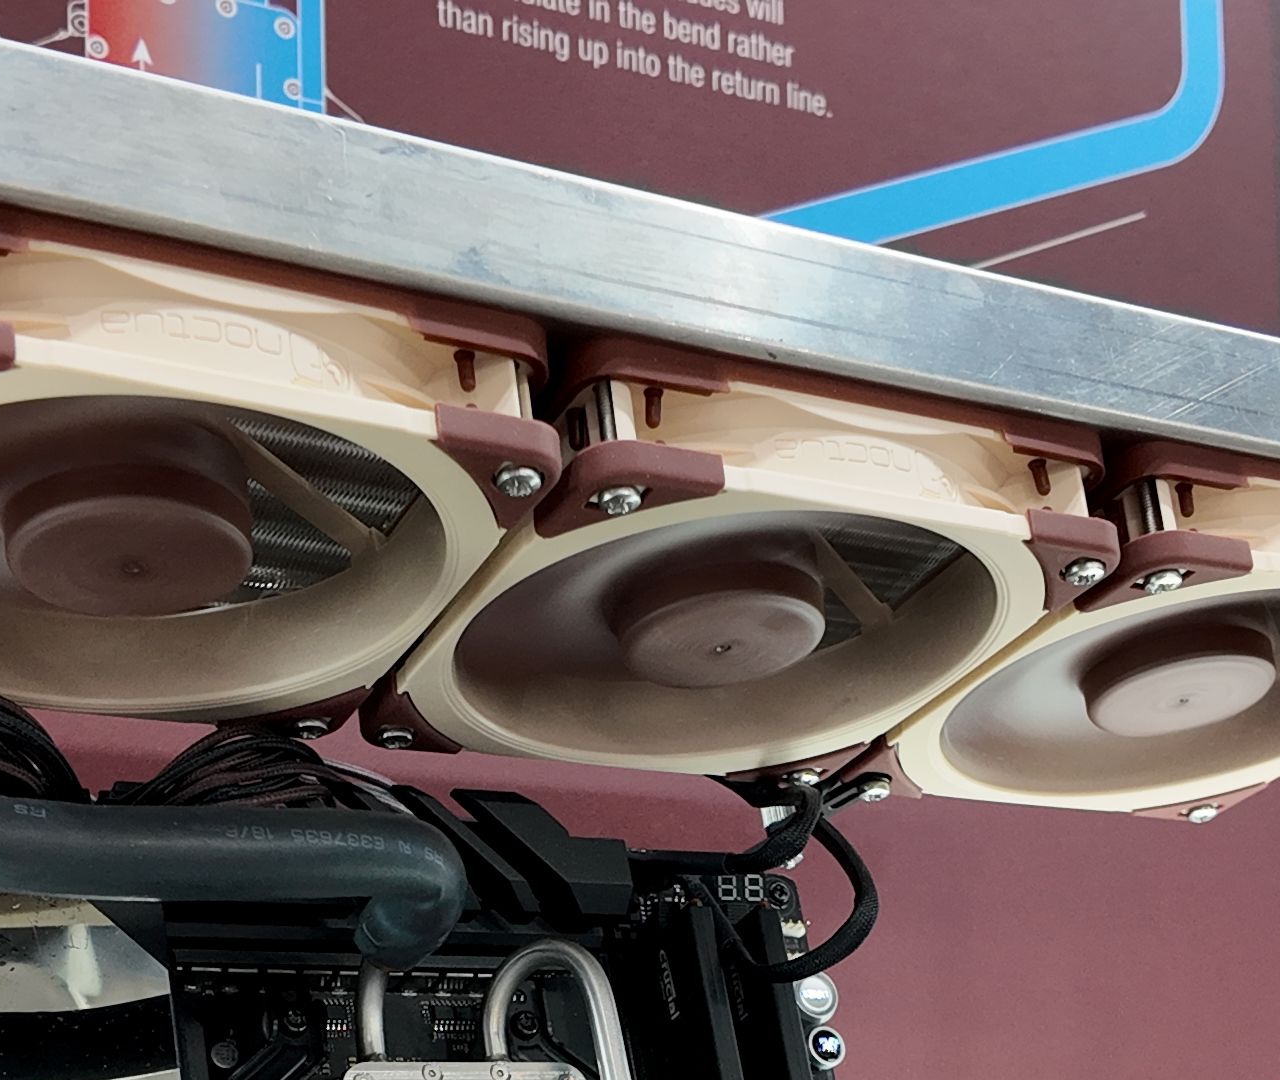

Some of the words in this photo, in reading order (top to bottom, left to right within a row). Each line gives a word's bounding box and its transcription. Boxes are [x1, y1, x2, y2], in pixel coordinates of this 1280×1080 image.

[437, 2, 494, 38] than
[502, 16, 570, 62] rising
[579, 37, 609, 68] up
[616, 40, 661, 77] into
[668, 54, 705, 88] the
[712, 68, 780, 105] return
[787, 82, 833, 118] line.
[619, 3, 656, 34] the
[663, 10, 720, 50] bend
[727, 30, 795, 68] rather
[99, 309, 282, 355] noctua
[291, 828, 385, 851] E337635
